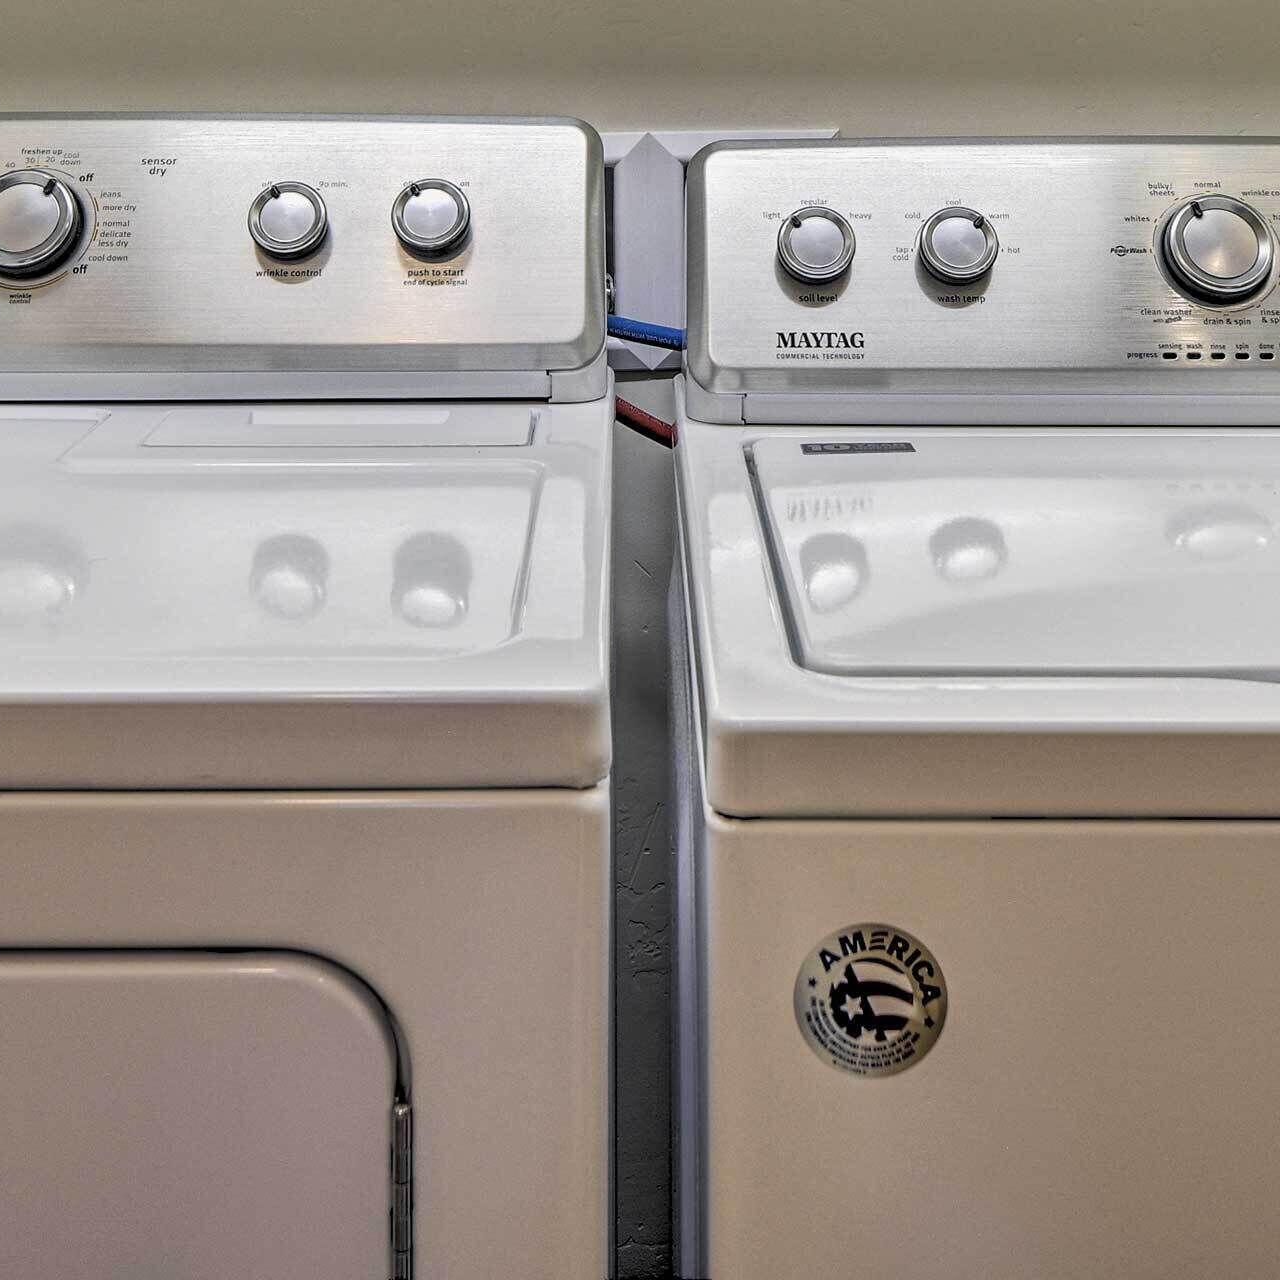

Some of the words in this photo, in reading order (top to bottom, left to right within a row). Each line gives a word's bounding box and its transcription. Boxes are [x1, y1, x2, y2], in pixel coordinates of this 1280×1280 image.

[52, 149, 63, 157] up
[141, 157, 178, 165] sensor
[149, 166, 166, 177] dry
[79, 173, 94, 182] off
[99, 190, 122, 199] jeans
[1241, 189, 1270, 197] wrinkle
[123, 203, 137, 212] dry
[762, 212, 781, 220] light
[100, 230, 132, 238] delicate
[115, 240, 129, 248] dry
[88, 254, 105, 262] cool
[106, 254, 128, 262] down
[72, 264, 88, 274] off
[255, 268, 289, 277] wrinkle
[290, 268, 322, 277] control
[407, 269, 430, 277] push
[798, 294, 815, 302] soil
[816, 294, 838, 302] level
[937, 294, 961, 303] wash
[962, 295, 986, 304] temp
[1140, 308, 1161, 316] clean
[1162, 308, 1192, 316] washer
[1260, 308, 1280, 316] rinse
[1203, 317, 1224, 326] drain
[1225, 318, 1232, 326] &
[1234, 318, 1252, 327] spin
[776, 332, 865, 348] MAYTAG
[1158, 342, 1183, 351] sensing
[1210, 342, 1226, 350] rinse
[1235, 342, 1249, 351] spin
[1259, 342, 1275, 350] done
[818, 930, 942, 1006] AMERICA
